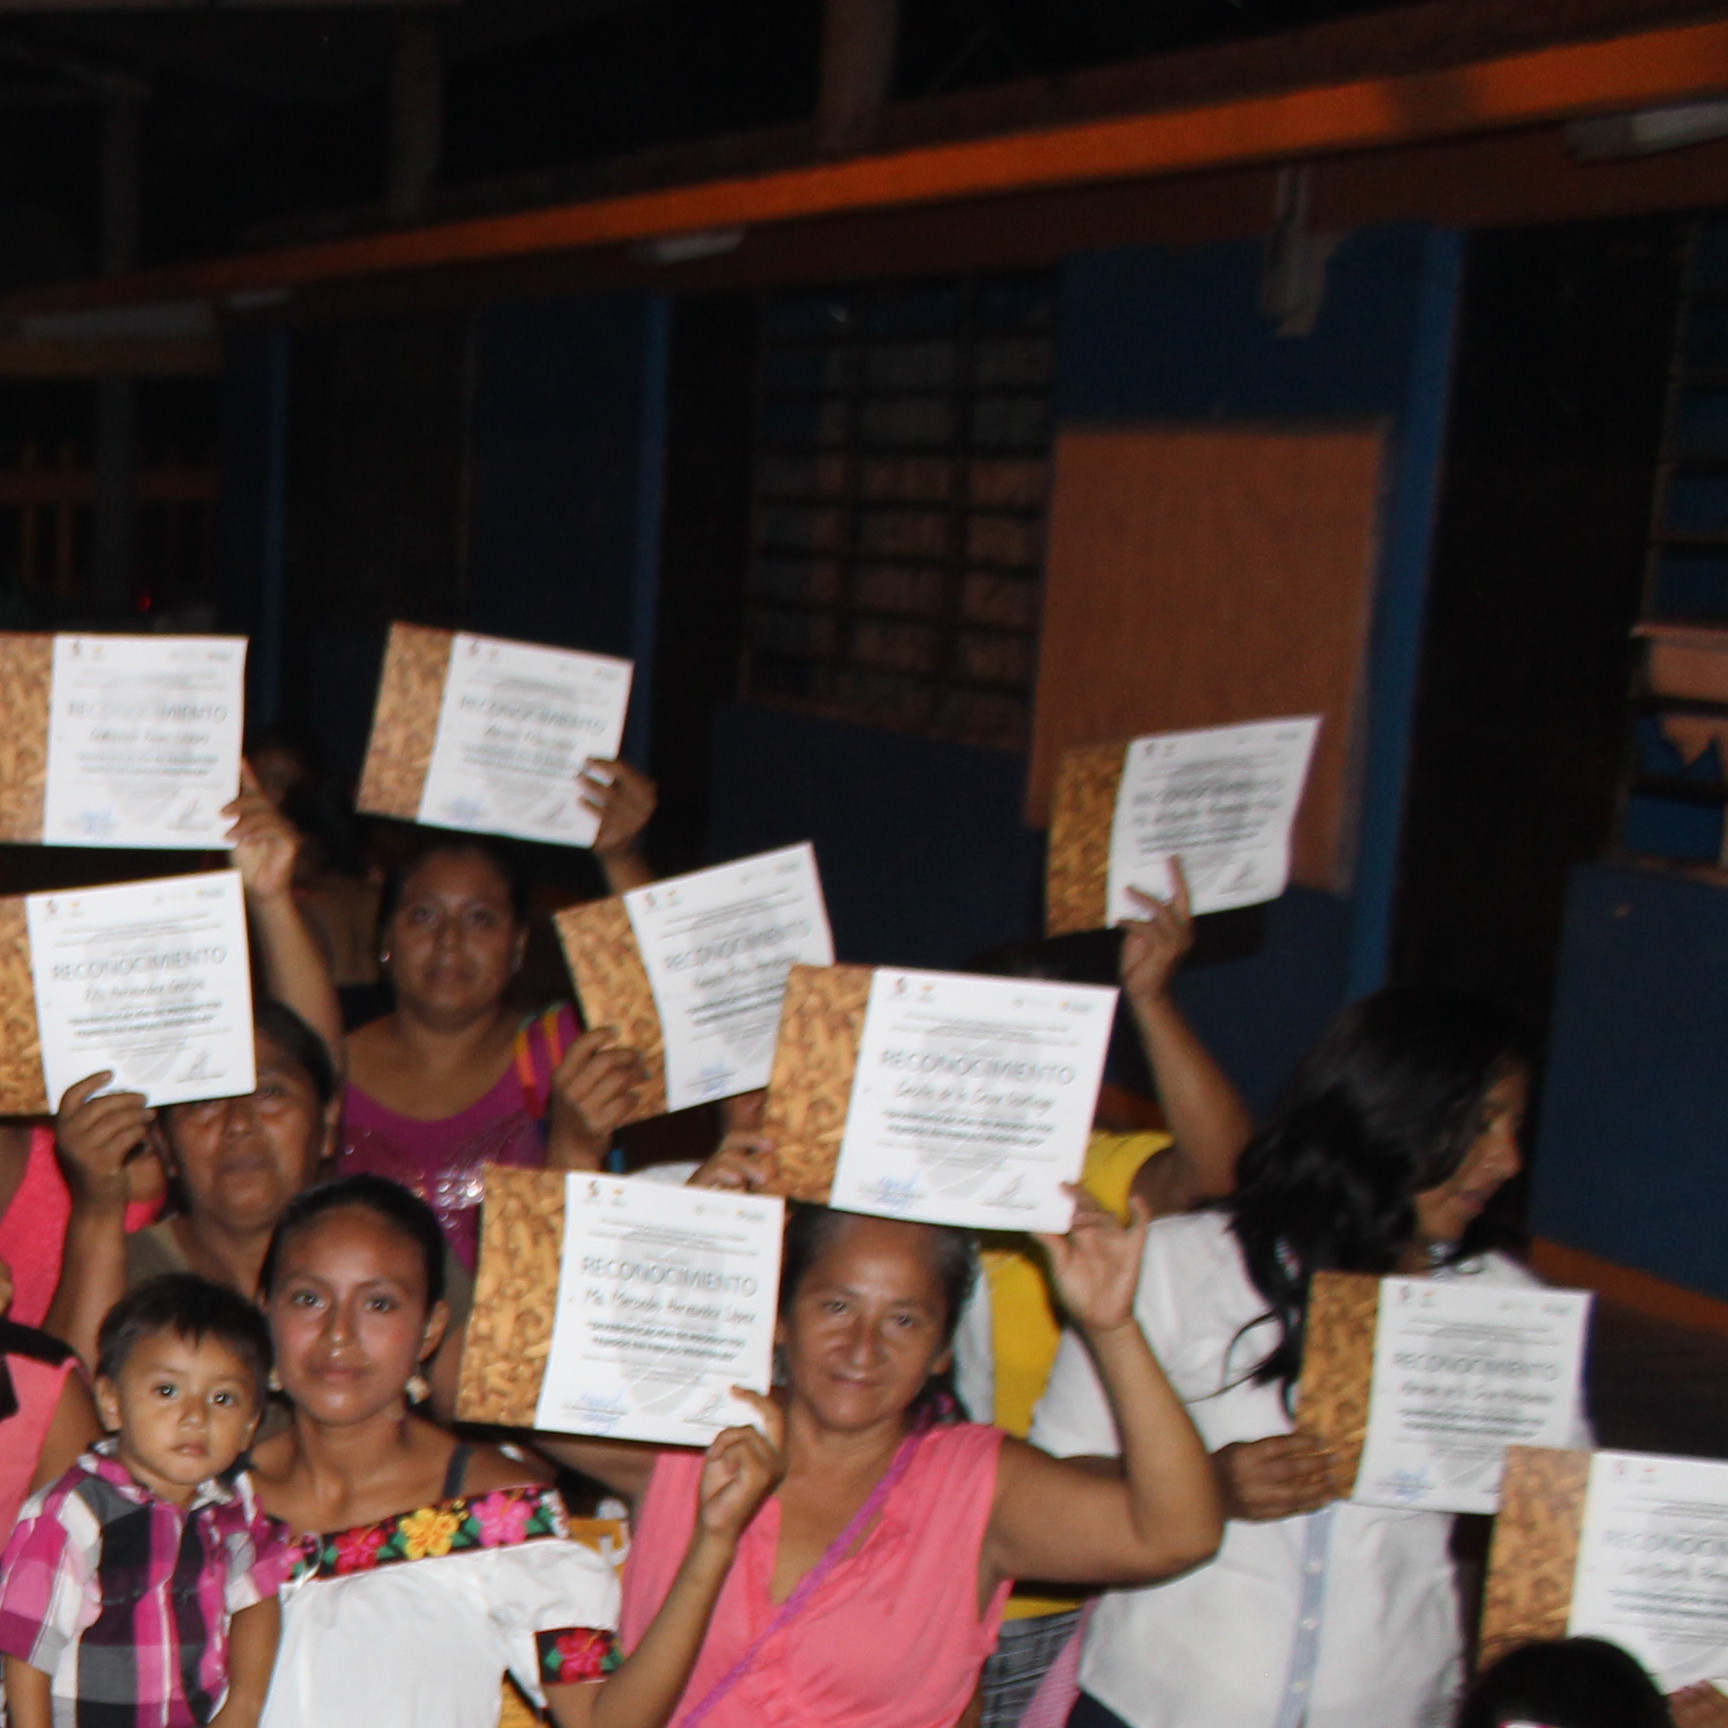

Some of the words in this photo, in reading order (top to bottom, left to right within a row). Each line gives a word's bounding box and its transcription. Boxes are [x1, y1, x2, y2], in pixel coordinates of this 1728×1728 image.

[53, 945, 227, 981] RECONOCIMIENTO
[881, 1049, 1077, 1085] RECONOCIMIENTO
[581, 1255, 759, 1299] RECONOCIMIENTO
